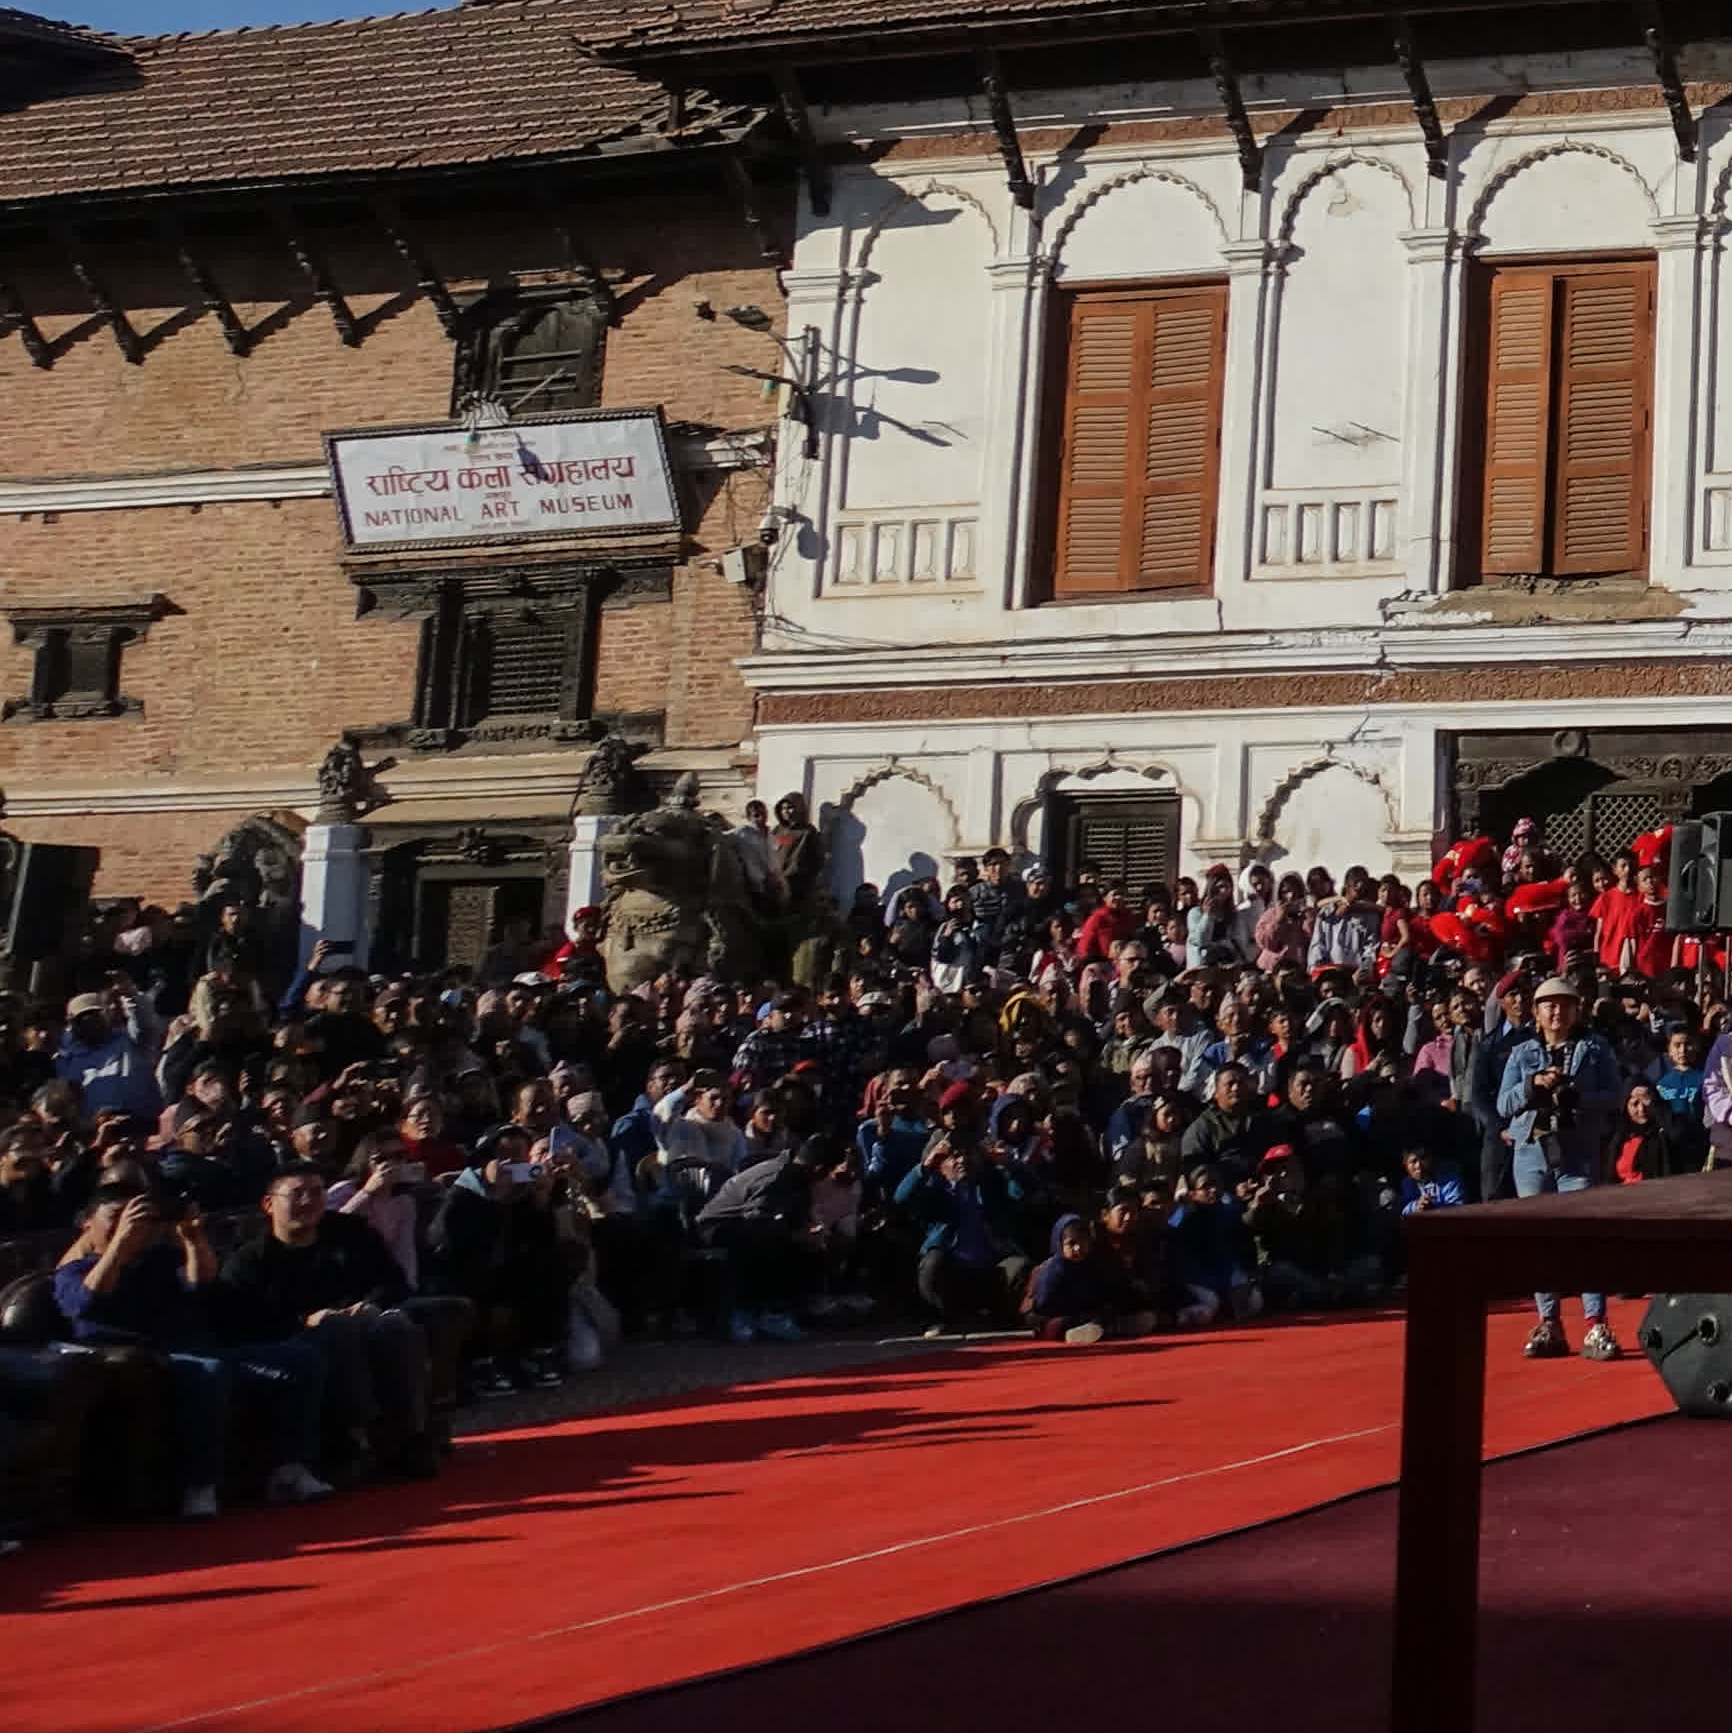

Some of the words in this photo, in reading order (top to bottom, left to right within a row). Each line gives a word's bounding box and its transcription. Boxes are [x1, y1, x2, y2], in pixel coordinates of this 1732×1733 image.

[457, 465, 511, 490] कला
[365, 505, 463, 527] NATIONAL
[480, 499, 520, 518] ART
[540, 493, 633, 515] MUSEUM
